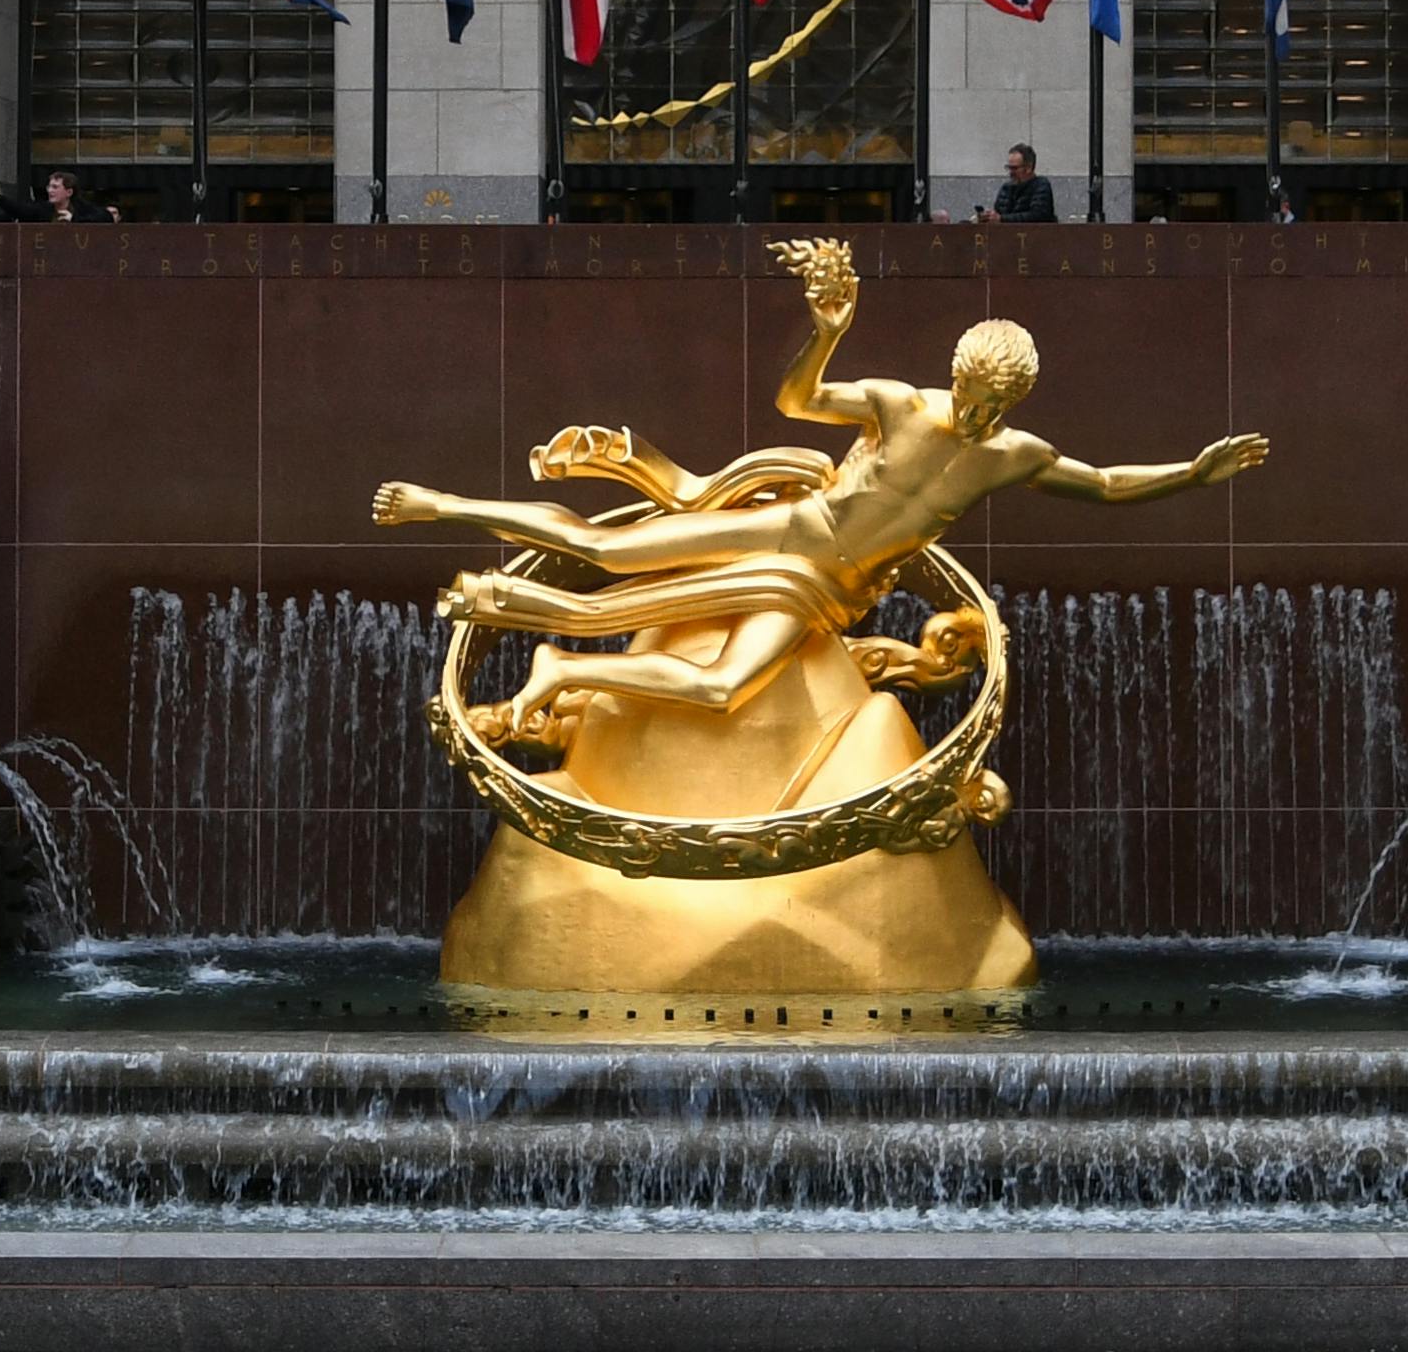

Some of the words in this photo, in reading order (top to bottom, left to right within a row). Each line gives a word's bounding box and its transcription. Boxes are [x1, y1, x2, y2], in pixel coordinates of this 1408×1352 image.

[205, 233, 473, 250] TEACHER
[549, 233, 601, 250] IN
[931, 232, 1029, 250] ART
[118, 258, 344, 275] PROVED
[417, 258, 475, 275] TO
[544, 258, 776, 276] MORTAL
[889, 257, 902, 274] A
[972, 257, 1157, 274] MEANS
[1230, 256, 1287, 274] TO
